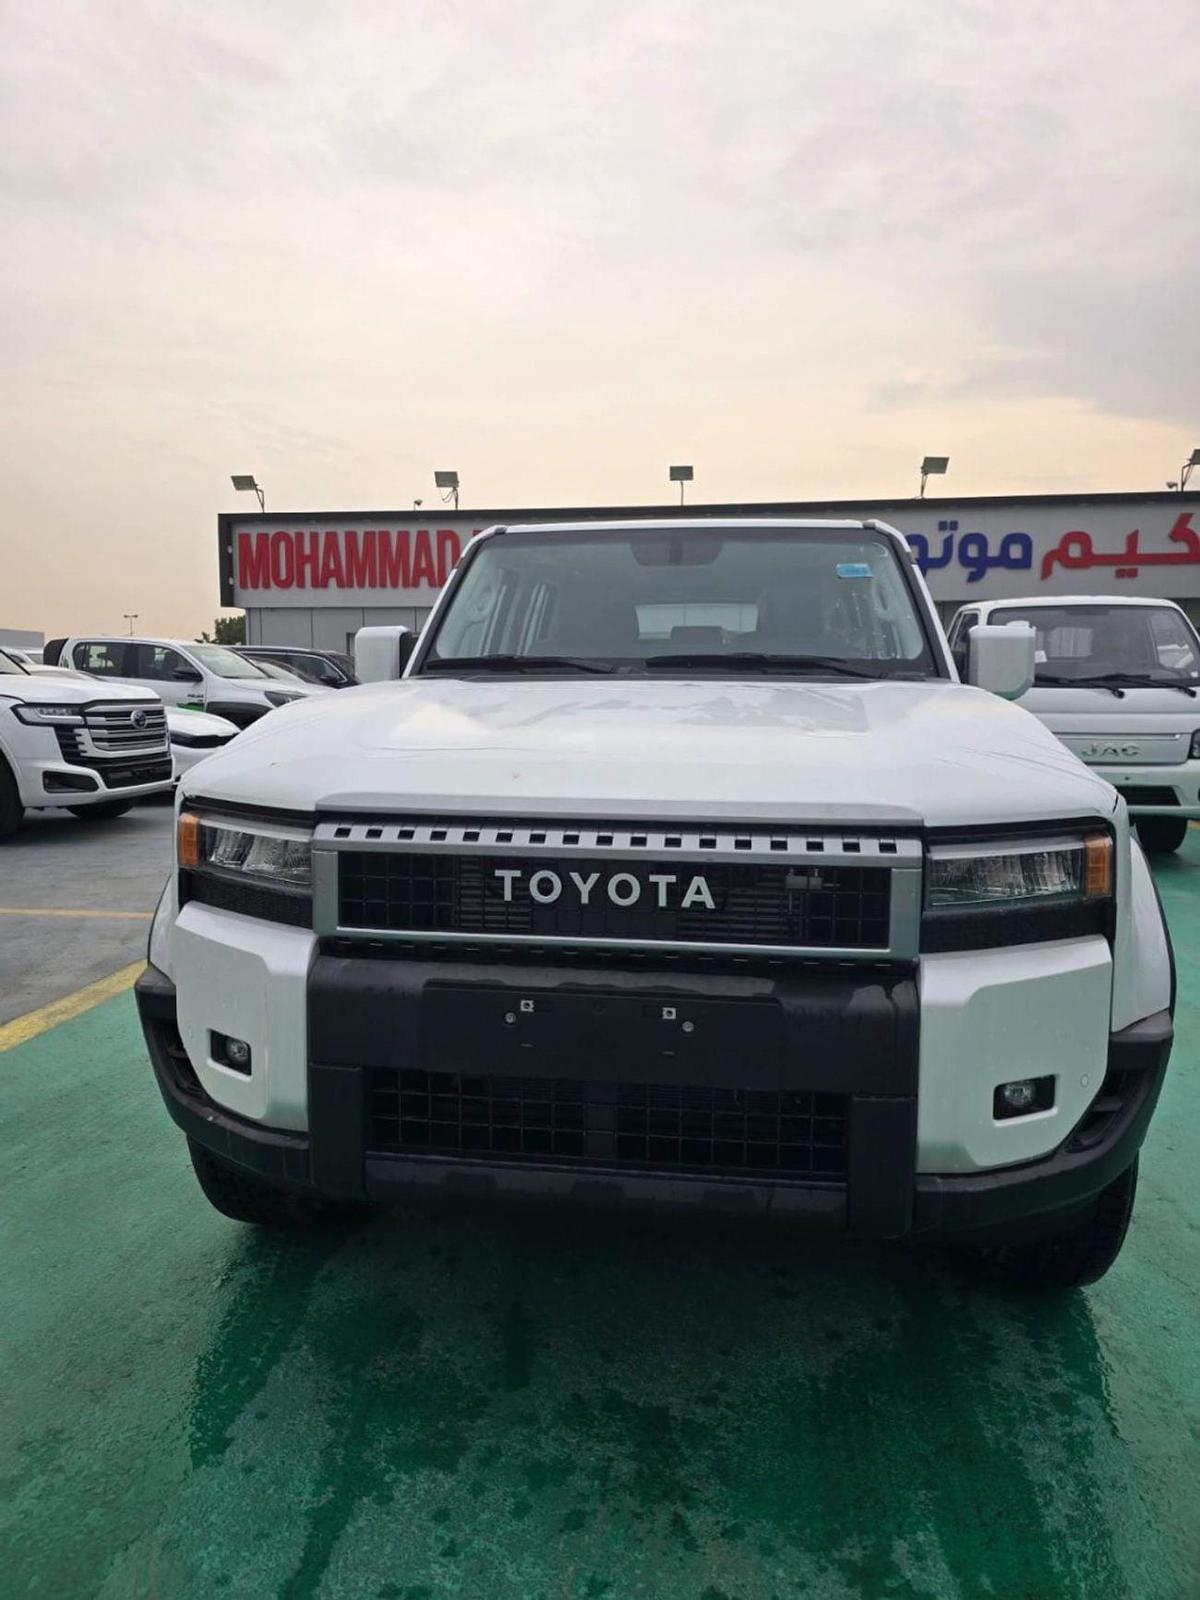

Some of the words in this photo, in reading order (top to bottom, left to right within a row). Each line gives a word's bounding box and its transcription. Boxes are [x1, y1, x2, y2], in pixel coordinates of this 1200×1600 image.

[238, 530, 461, 589] MOHAMMAD
[1081, 742, 1140, 758] JAC
[494, 869, 716, 910] TOYOTA
